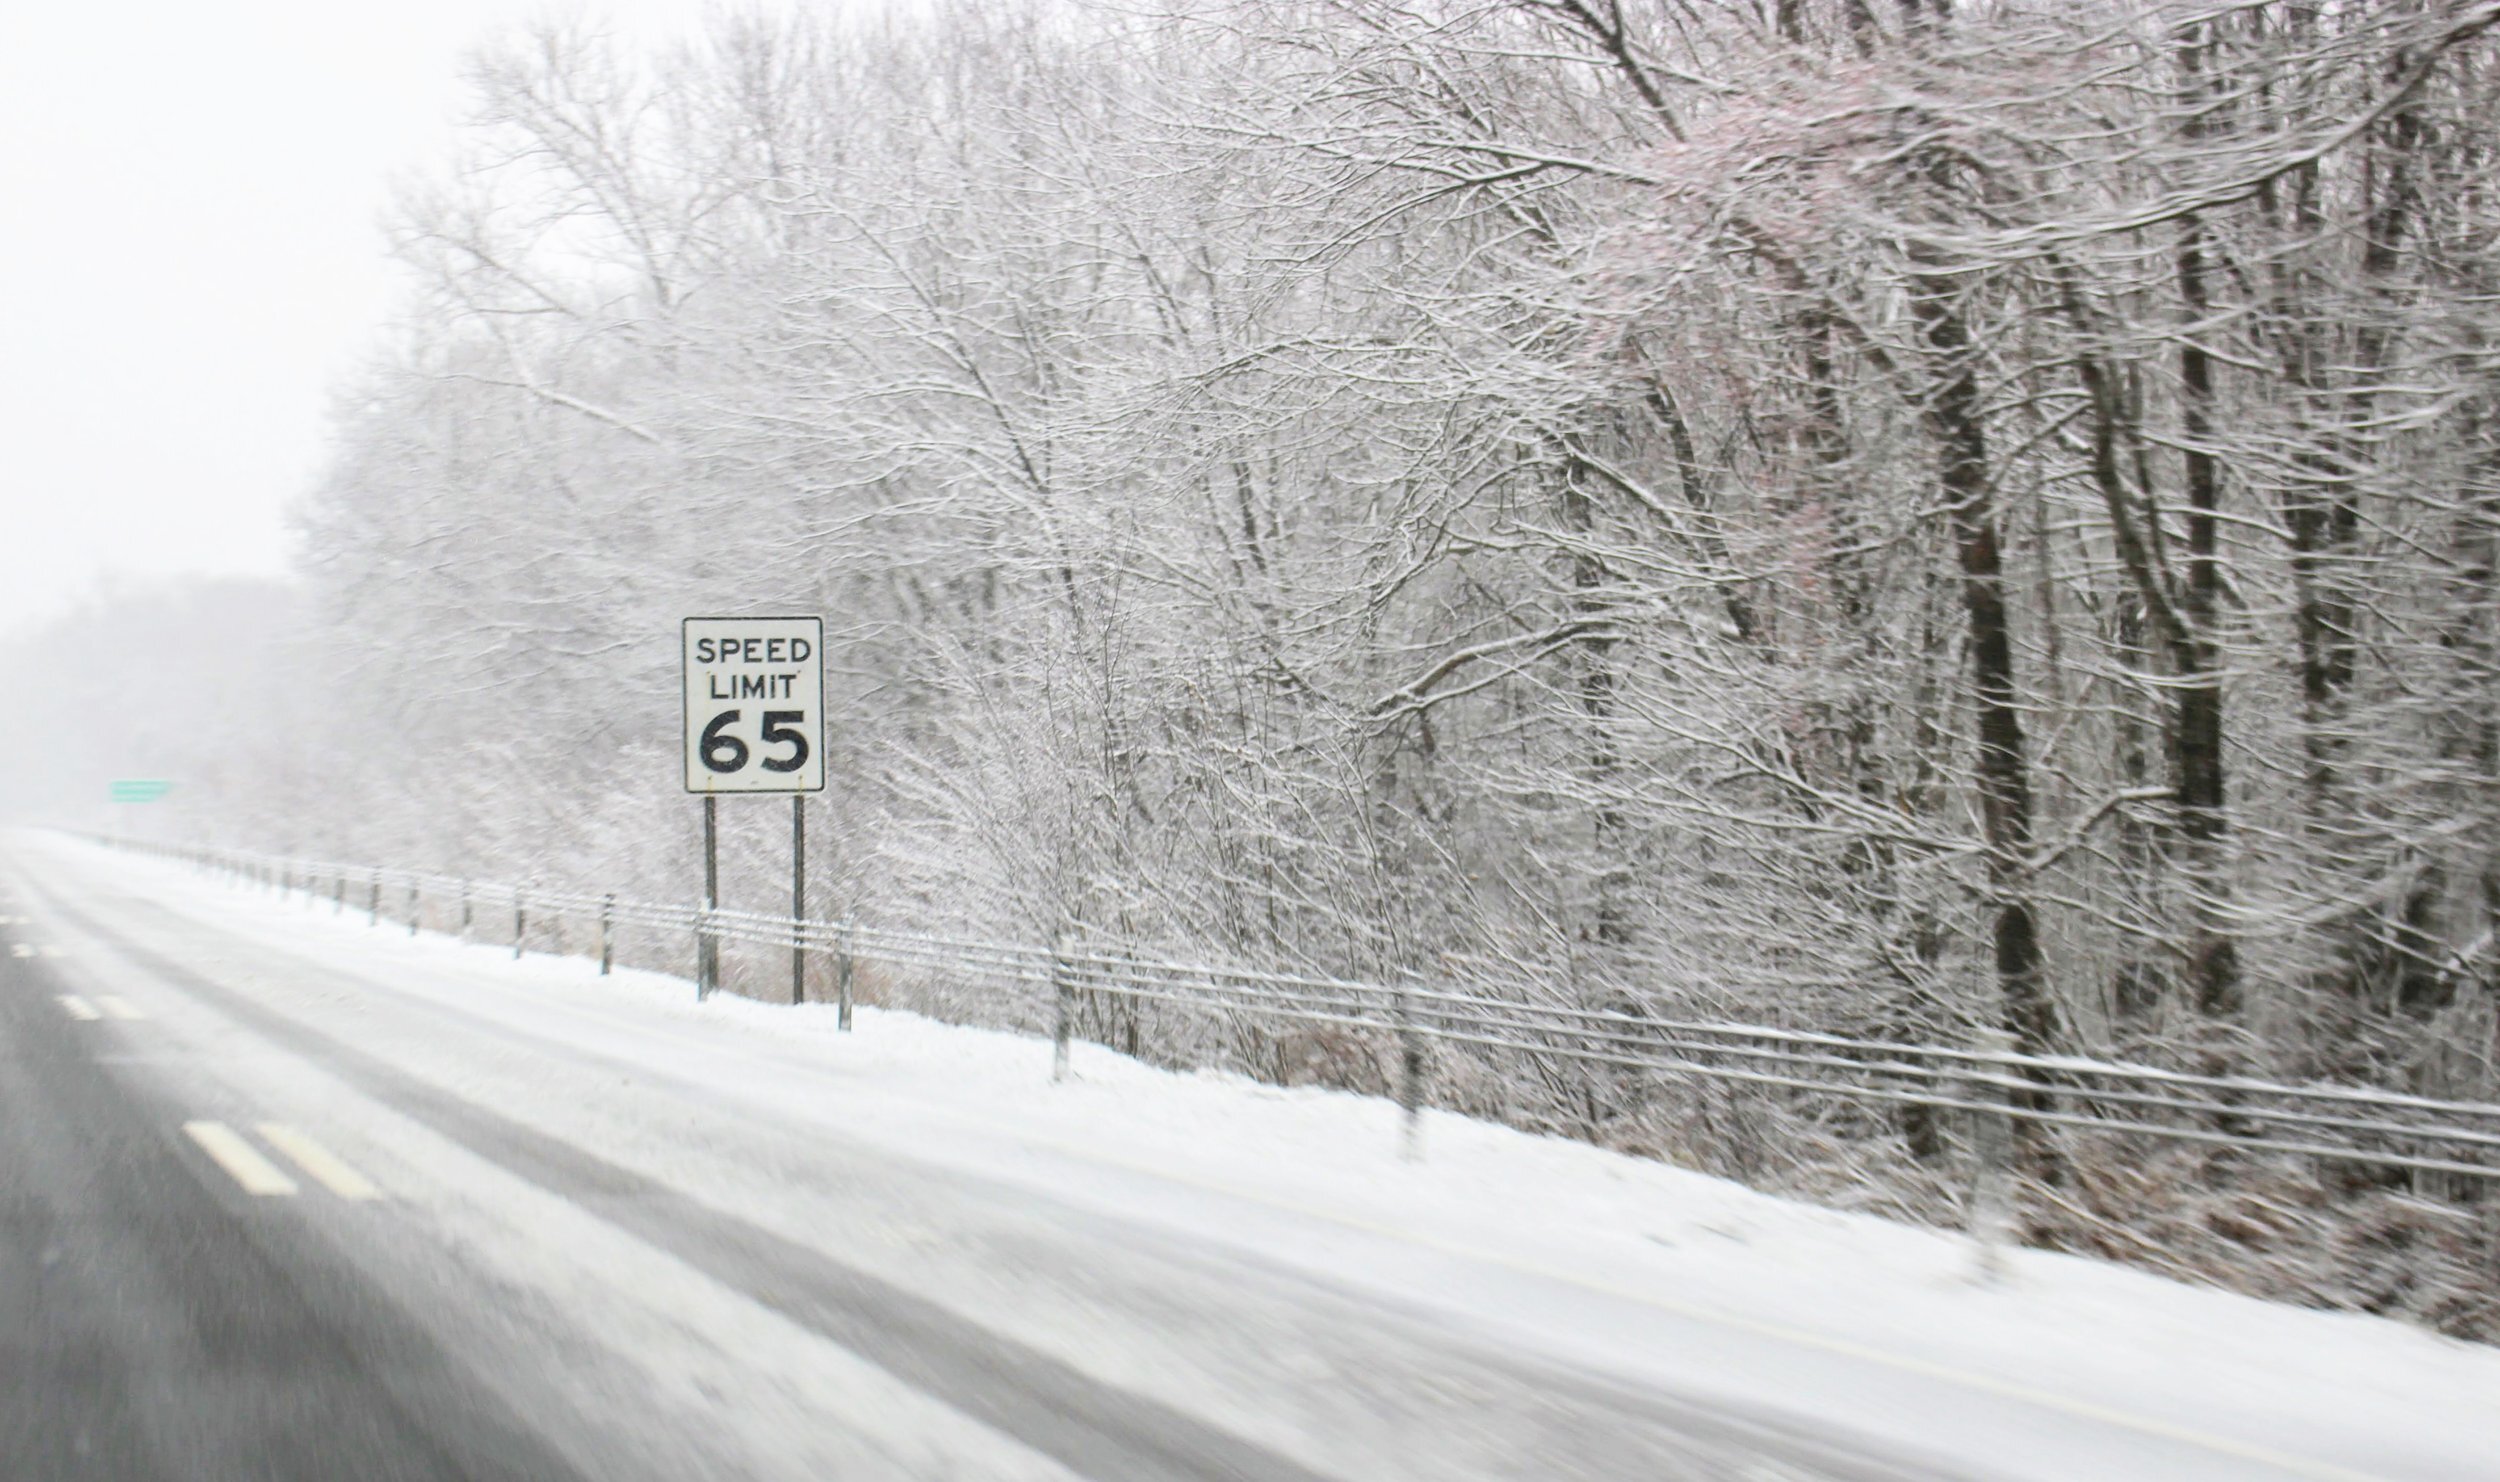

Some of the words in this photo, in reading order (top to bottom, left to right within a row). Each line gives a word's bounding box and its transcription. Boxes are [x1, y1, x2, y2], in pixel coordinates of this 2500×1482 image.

[696, 637, 812, 664] SPEED
[710, 674, 797, 700] LIMIT
[699, 709, 810, 774] 65
